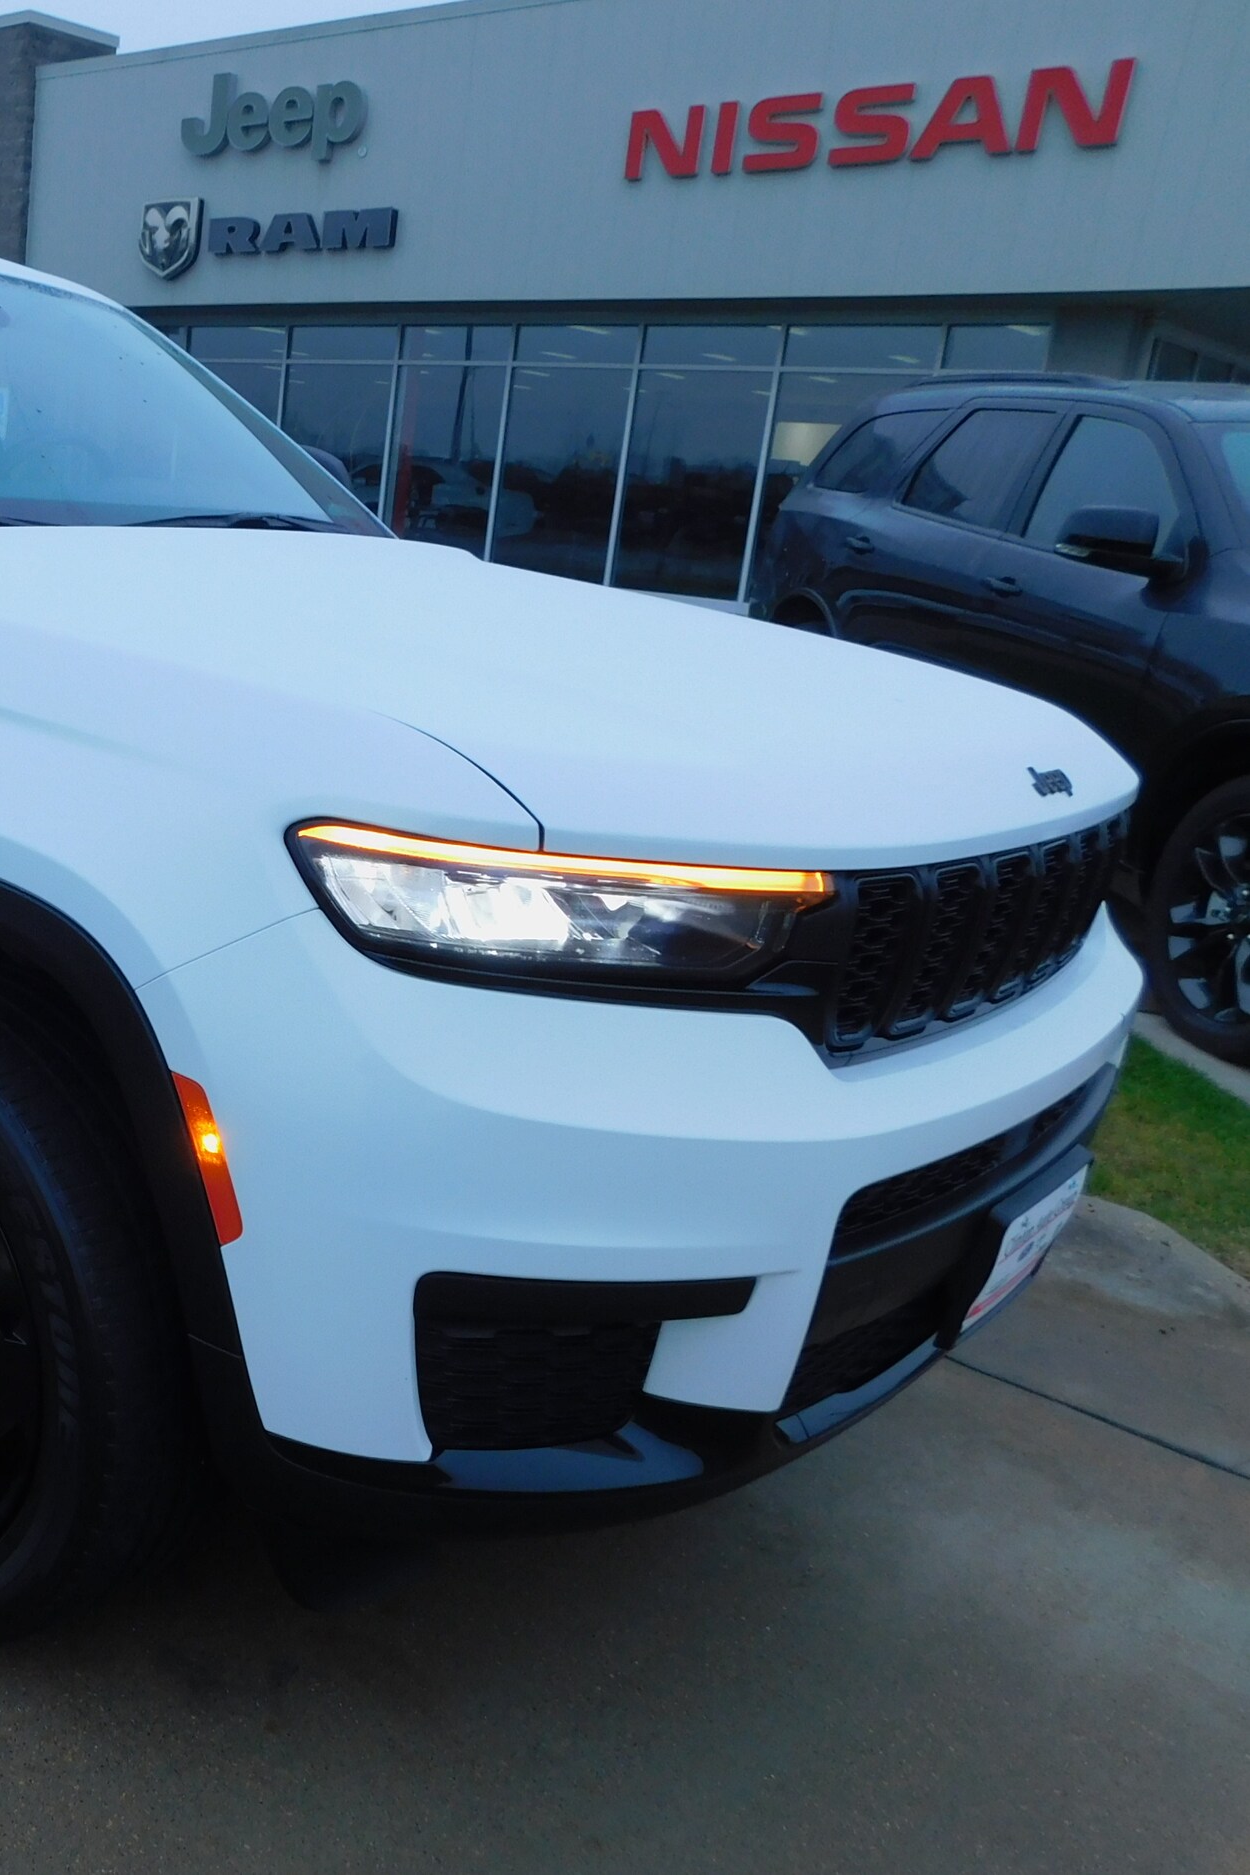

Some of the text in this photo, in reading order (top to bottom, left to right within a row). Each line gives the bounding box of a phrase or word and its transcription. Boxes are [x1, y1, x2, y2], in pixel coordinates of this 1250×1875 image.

[181, 72, 369, 163] Jeep
[624, 57, 1138, 181] NISSAN
[208, 206, 399, 256] RAM
